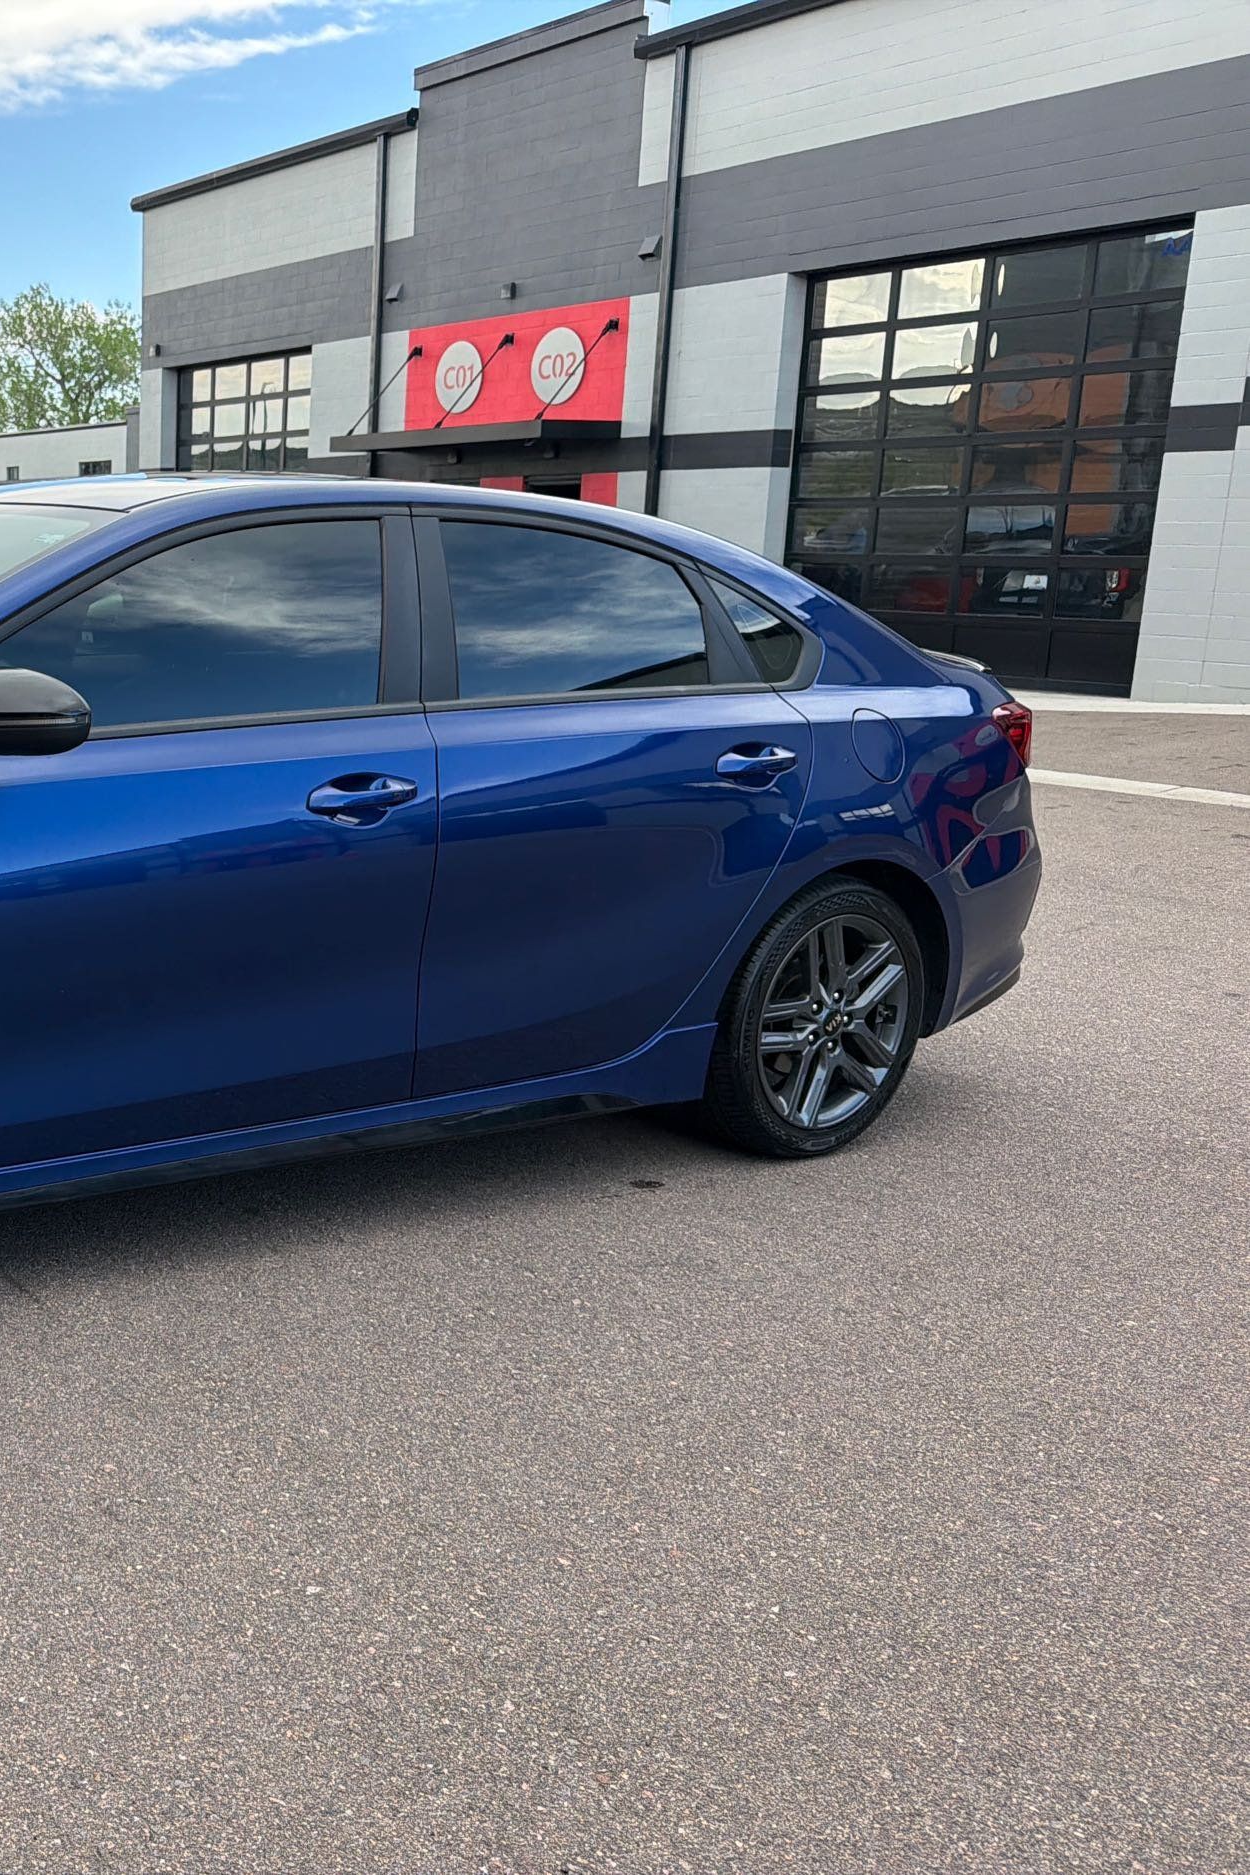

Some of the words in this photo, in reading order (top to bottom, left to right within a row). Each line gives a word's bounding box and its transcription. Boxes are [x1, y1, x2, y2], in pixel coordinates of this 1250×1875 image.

[443, 363, 474, 389] C01
[538, 352, 577, 380] C02
[825, 1013, 842, 1032] KIA
